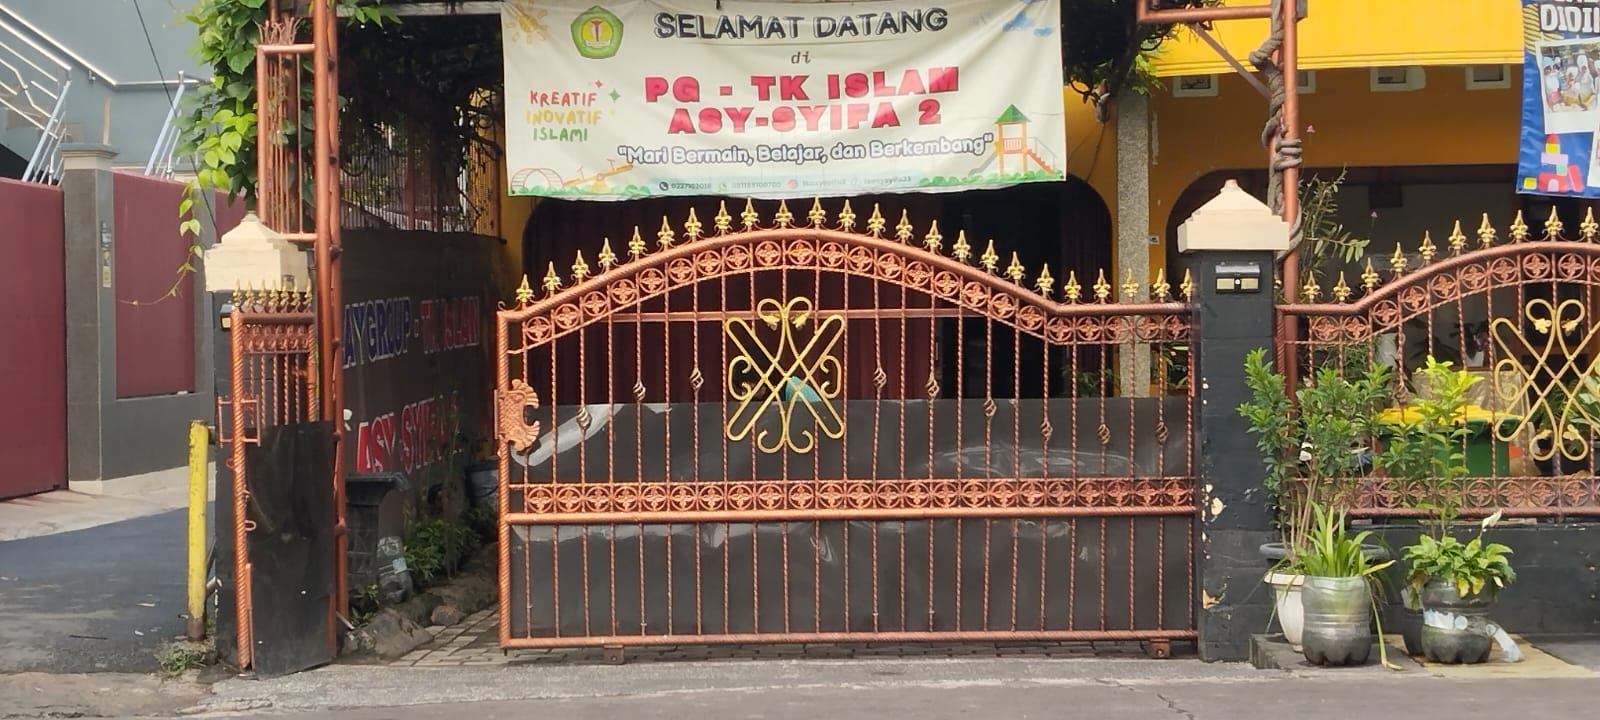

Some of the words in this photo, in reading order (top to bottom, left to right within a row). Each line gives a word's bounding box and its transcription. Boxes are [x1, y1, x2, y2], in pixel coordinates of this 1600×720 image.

[654, 12, 805, 39] SELAMAT
[813, 7, 948, 38] DATANG
[791, 51, 811, 64] di
[644, 76, 700, 103] PG
[751, 74, 810, 102] TK
[827, 66, 959, 100] ISLAM
[529, 90, 598, 107] KREATIF
[526, 109, 602, 125] INOVATIF
[667, 101, 901, 135] ASY-SYIFA
[918, 98, 941, 125] 2
[533, 127, 588, 142] ISLAMI
[671, 146, 754, 166] Bermain,
[757, 142, 829, 165] Belajar,
[831, 142, 866, 159] dan
[342, 296, 411, 369] AYGROUP
